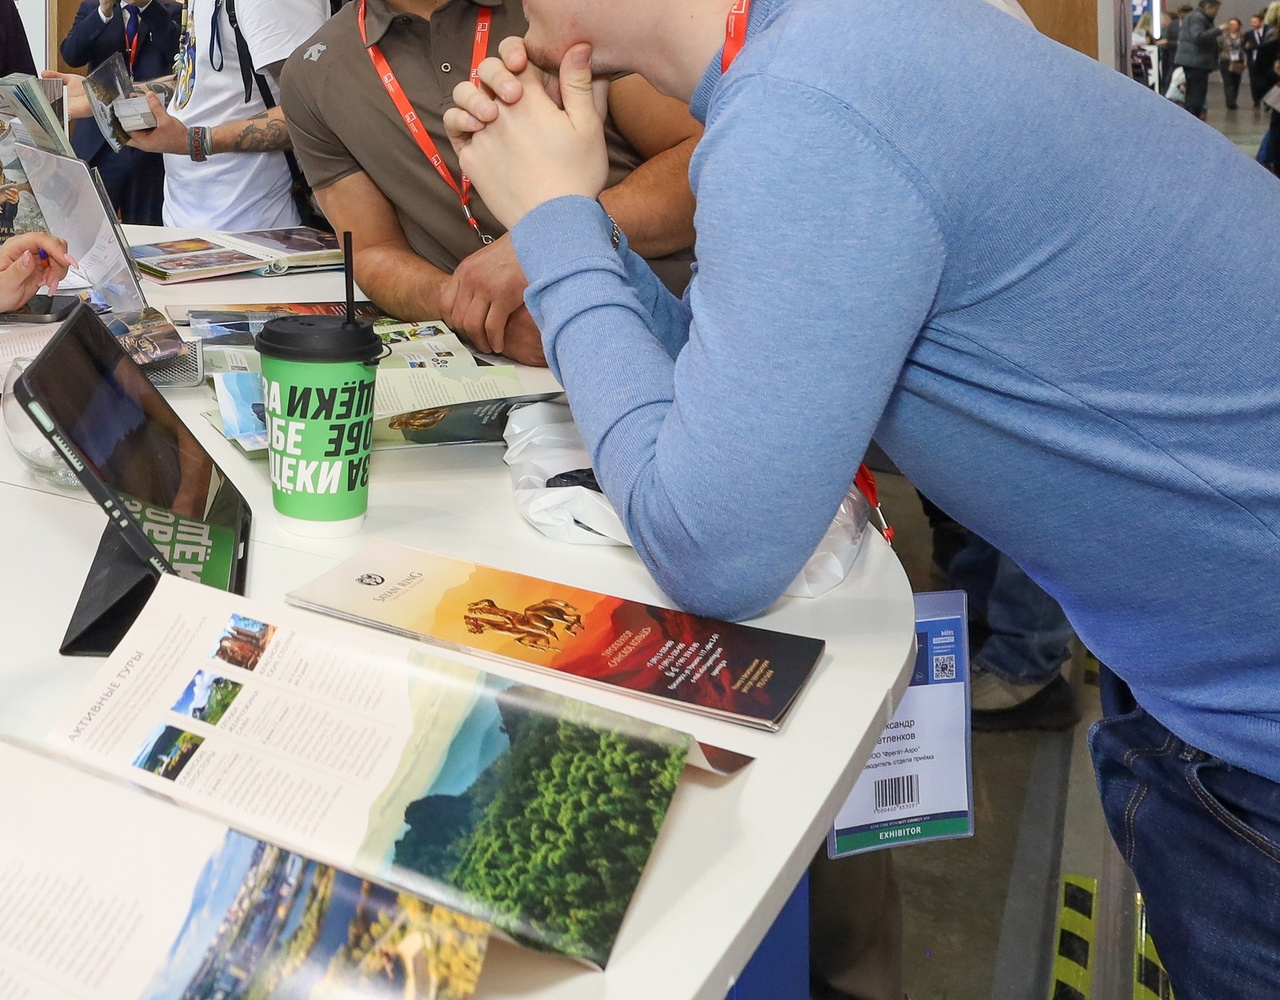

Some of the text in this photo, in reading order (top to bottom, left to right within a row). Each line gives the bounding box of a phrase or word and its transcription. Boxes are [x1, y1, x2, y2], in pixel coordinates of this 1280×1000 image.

[398, 571, 423, 588] RING
[68, 650, 145, 744] АКТИВНЫЕ ТУРЫ
[883, 719, 916, 731] ксандр
[879, 826, 922, 840] EXHIBITOR
